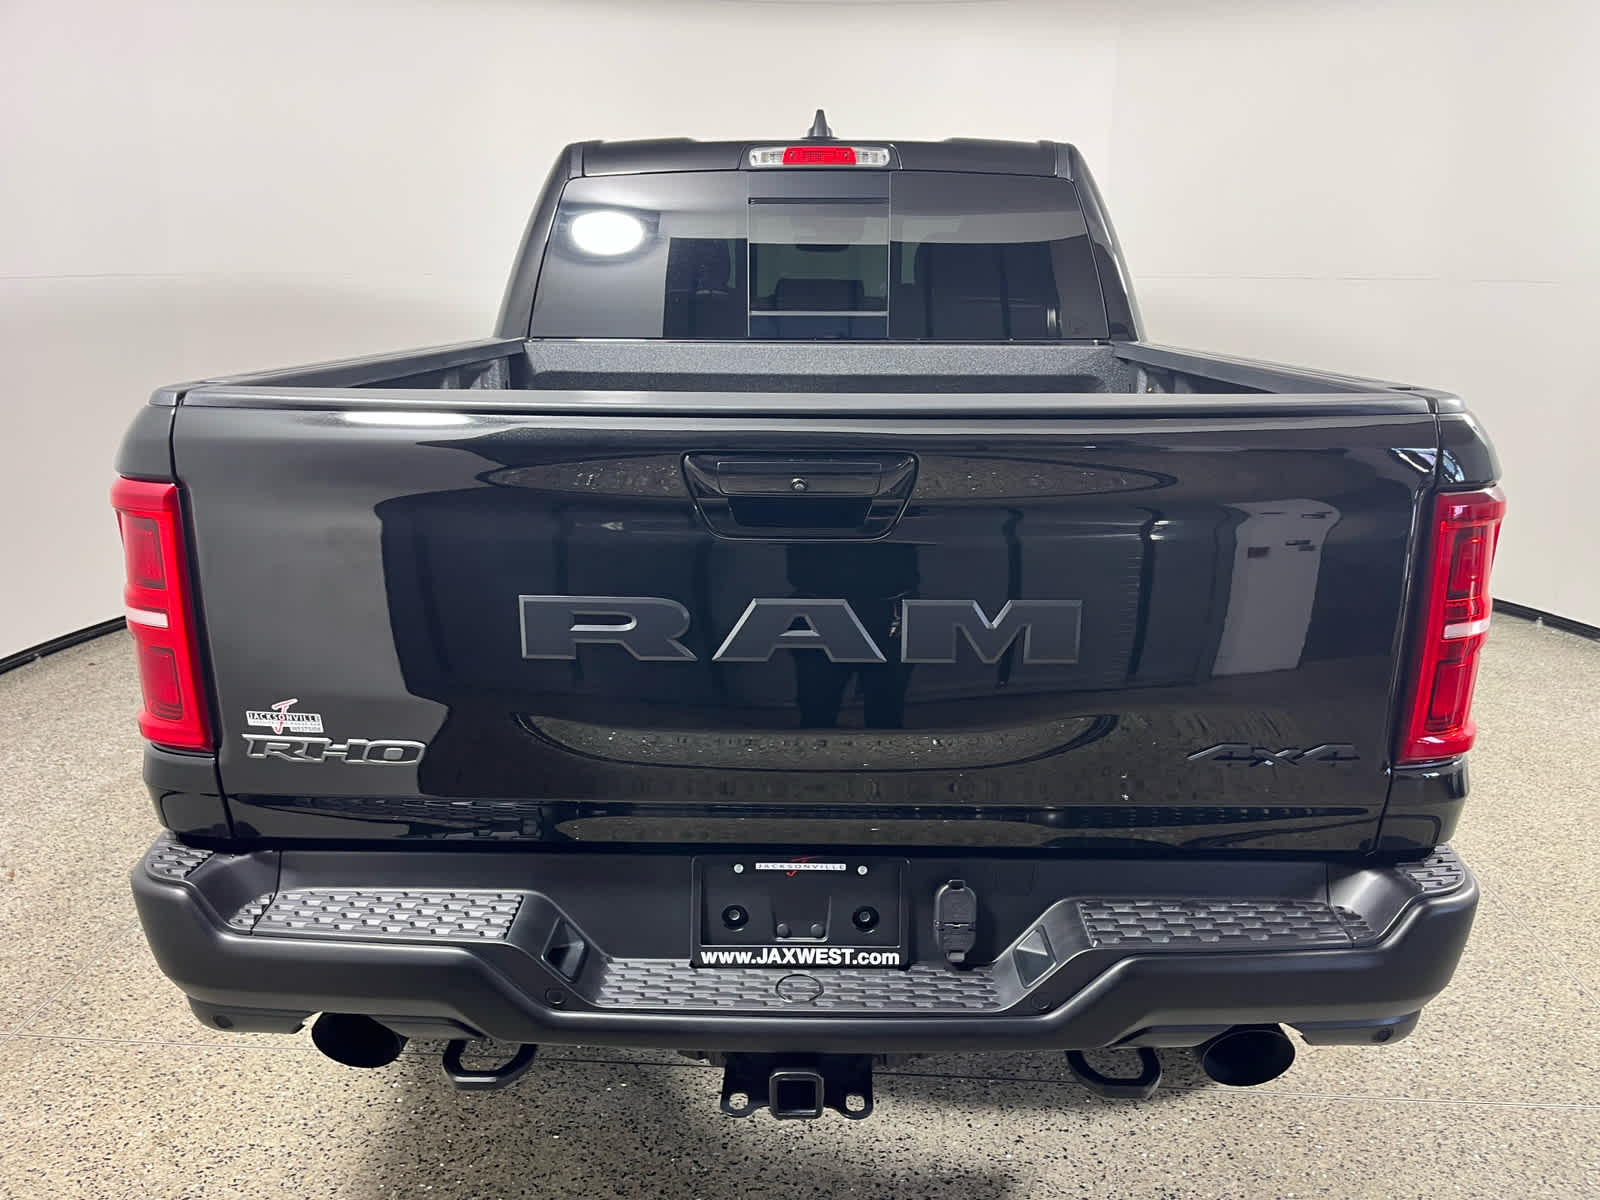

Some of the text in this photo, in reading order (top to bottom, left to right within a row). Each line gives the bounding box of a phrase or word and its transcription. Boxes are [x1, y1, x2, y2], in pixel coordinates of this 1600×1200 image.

[518, 594, 1083, 664] RAM
[247, 711, 320, 723] JACKSONVILLE
[242, 734, 426, 766] RHO
[700, 948, 900, 966] www.JAXWEST.com
